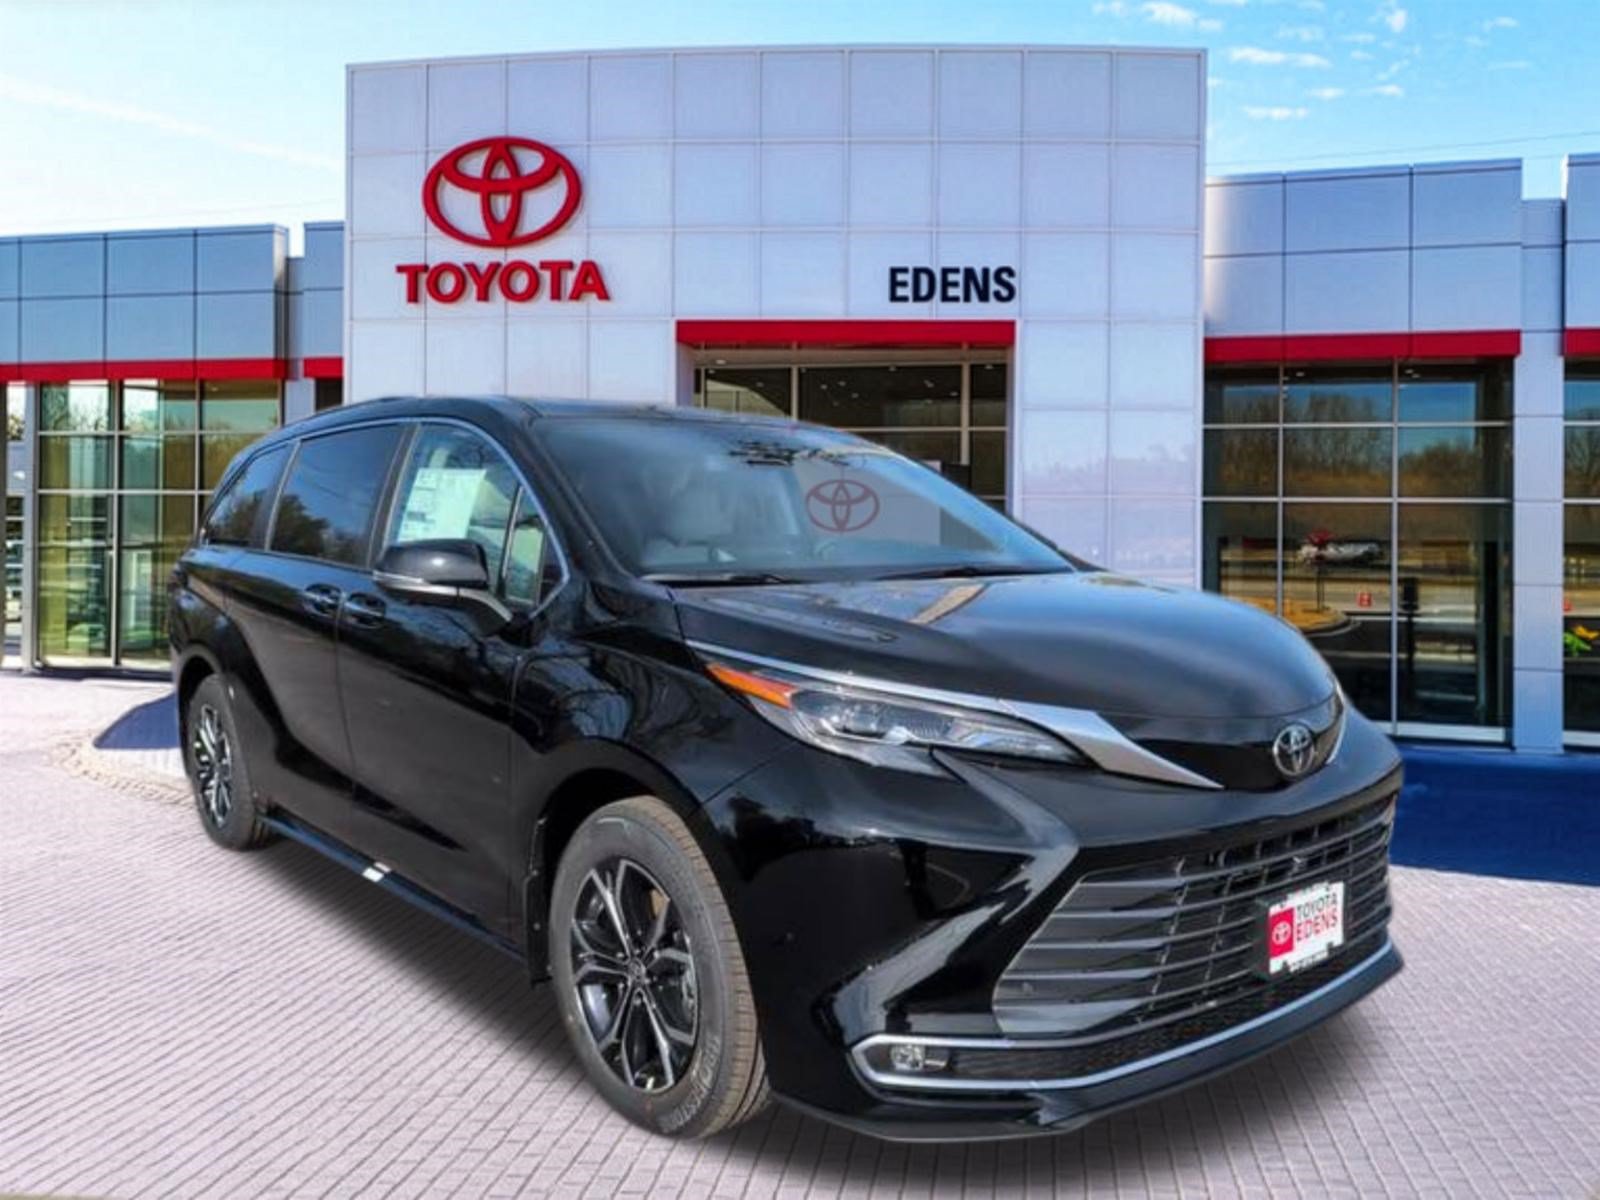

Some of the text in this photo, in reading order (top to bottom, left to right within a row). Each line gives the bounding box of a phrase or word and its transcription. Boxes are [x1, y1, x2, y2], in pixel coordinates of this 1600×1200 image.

[396, 259, 611, 304] TOYOTA
[889, 266, 1017, 303] EDENS
[1296, 892, 1338, 920] TOYOTA
[1296, 906, 1338, 942] EDENS
